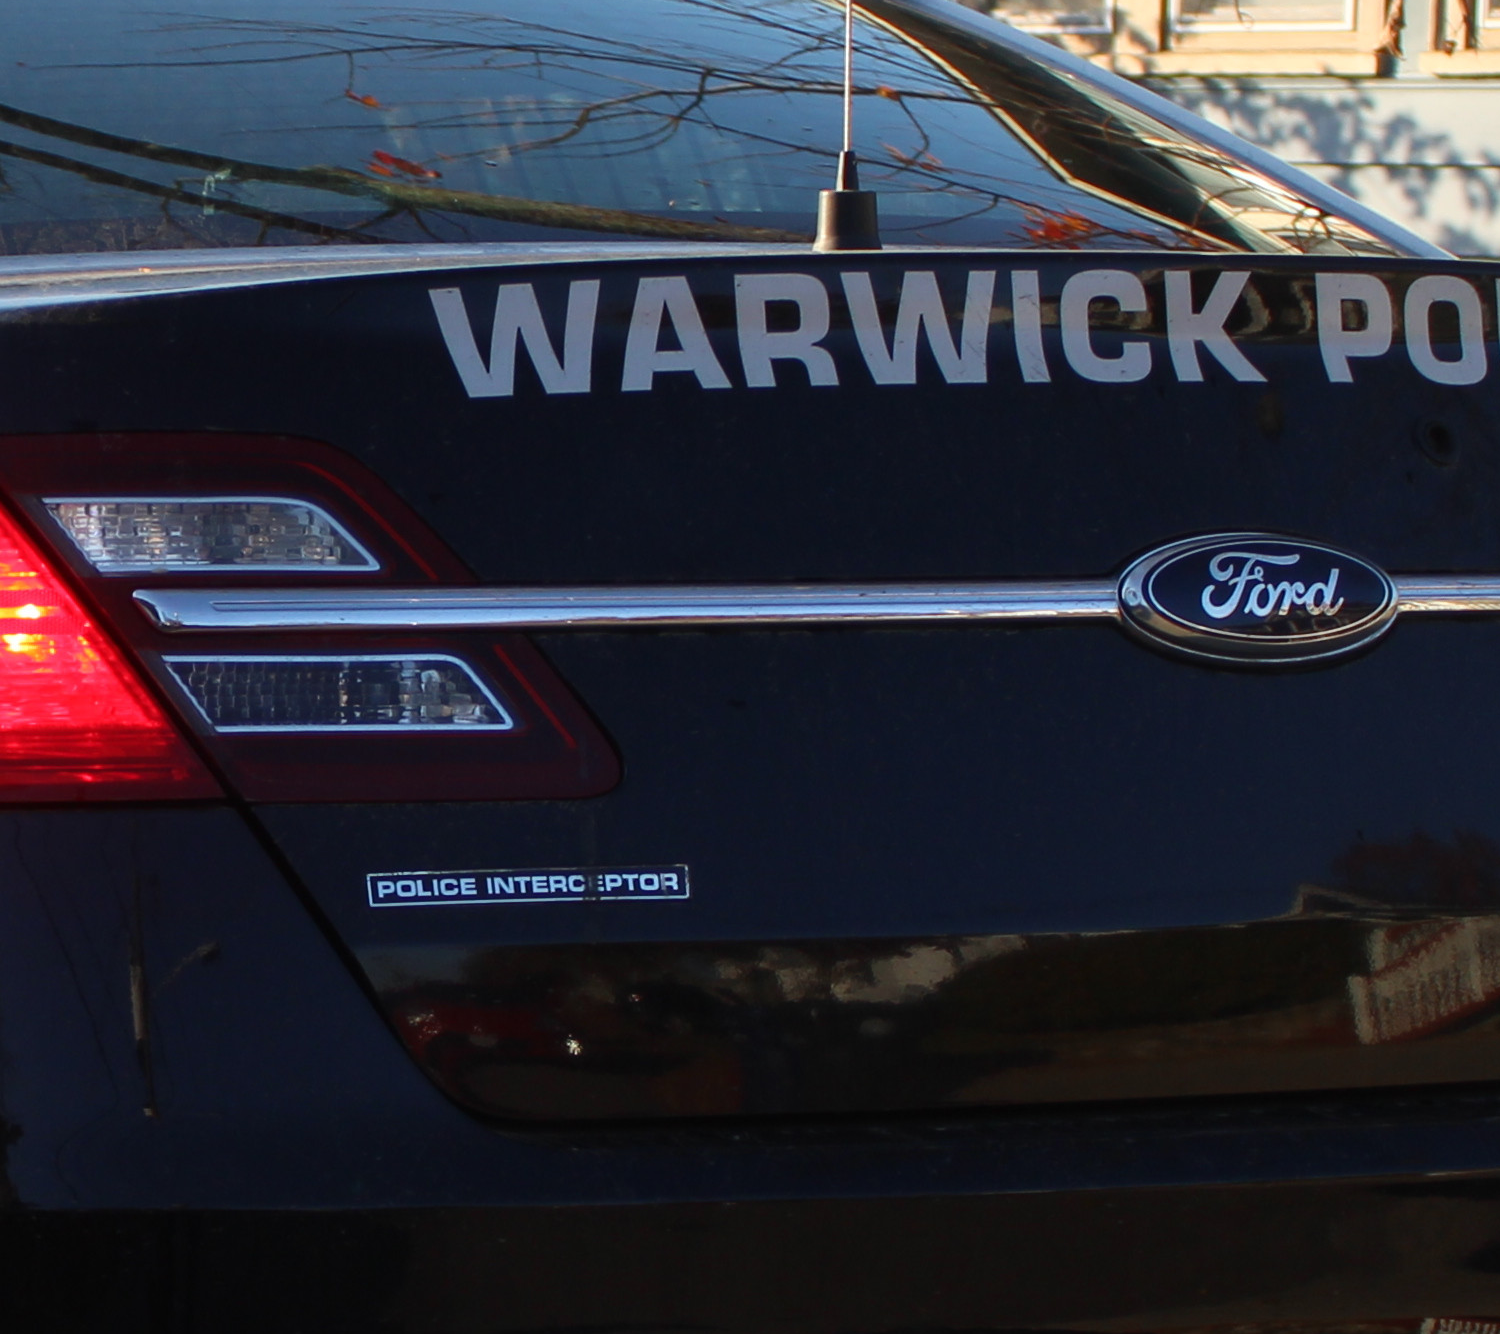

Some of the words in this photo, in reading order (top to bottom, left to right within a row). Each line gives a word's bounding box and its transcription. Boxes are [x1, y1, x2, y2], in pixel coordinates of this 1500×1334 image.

[428, 270, 1268, 398] WARWICK
[1201, 551, 1344, 619] Ford
[376, 877, 478, 898] POLICE
